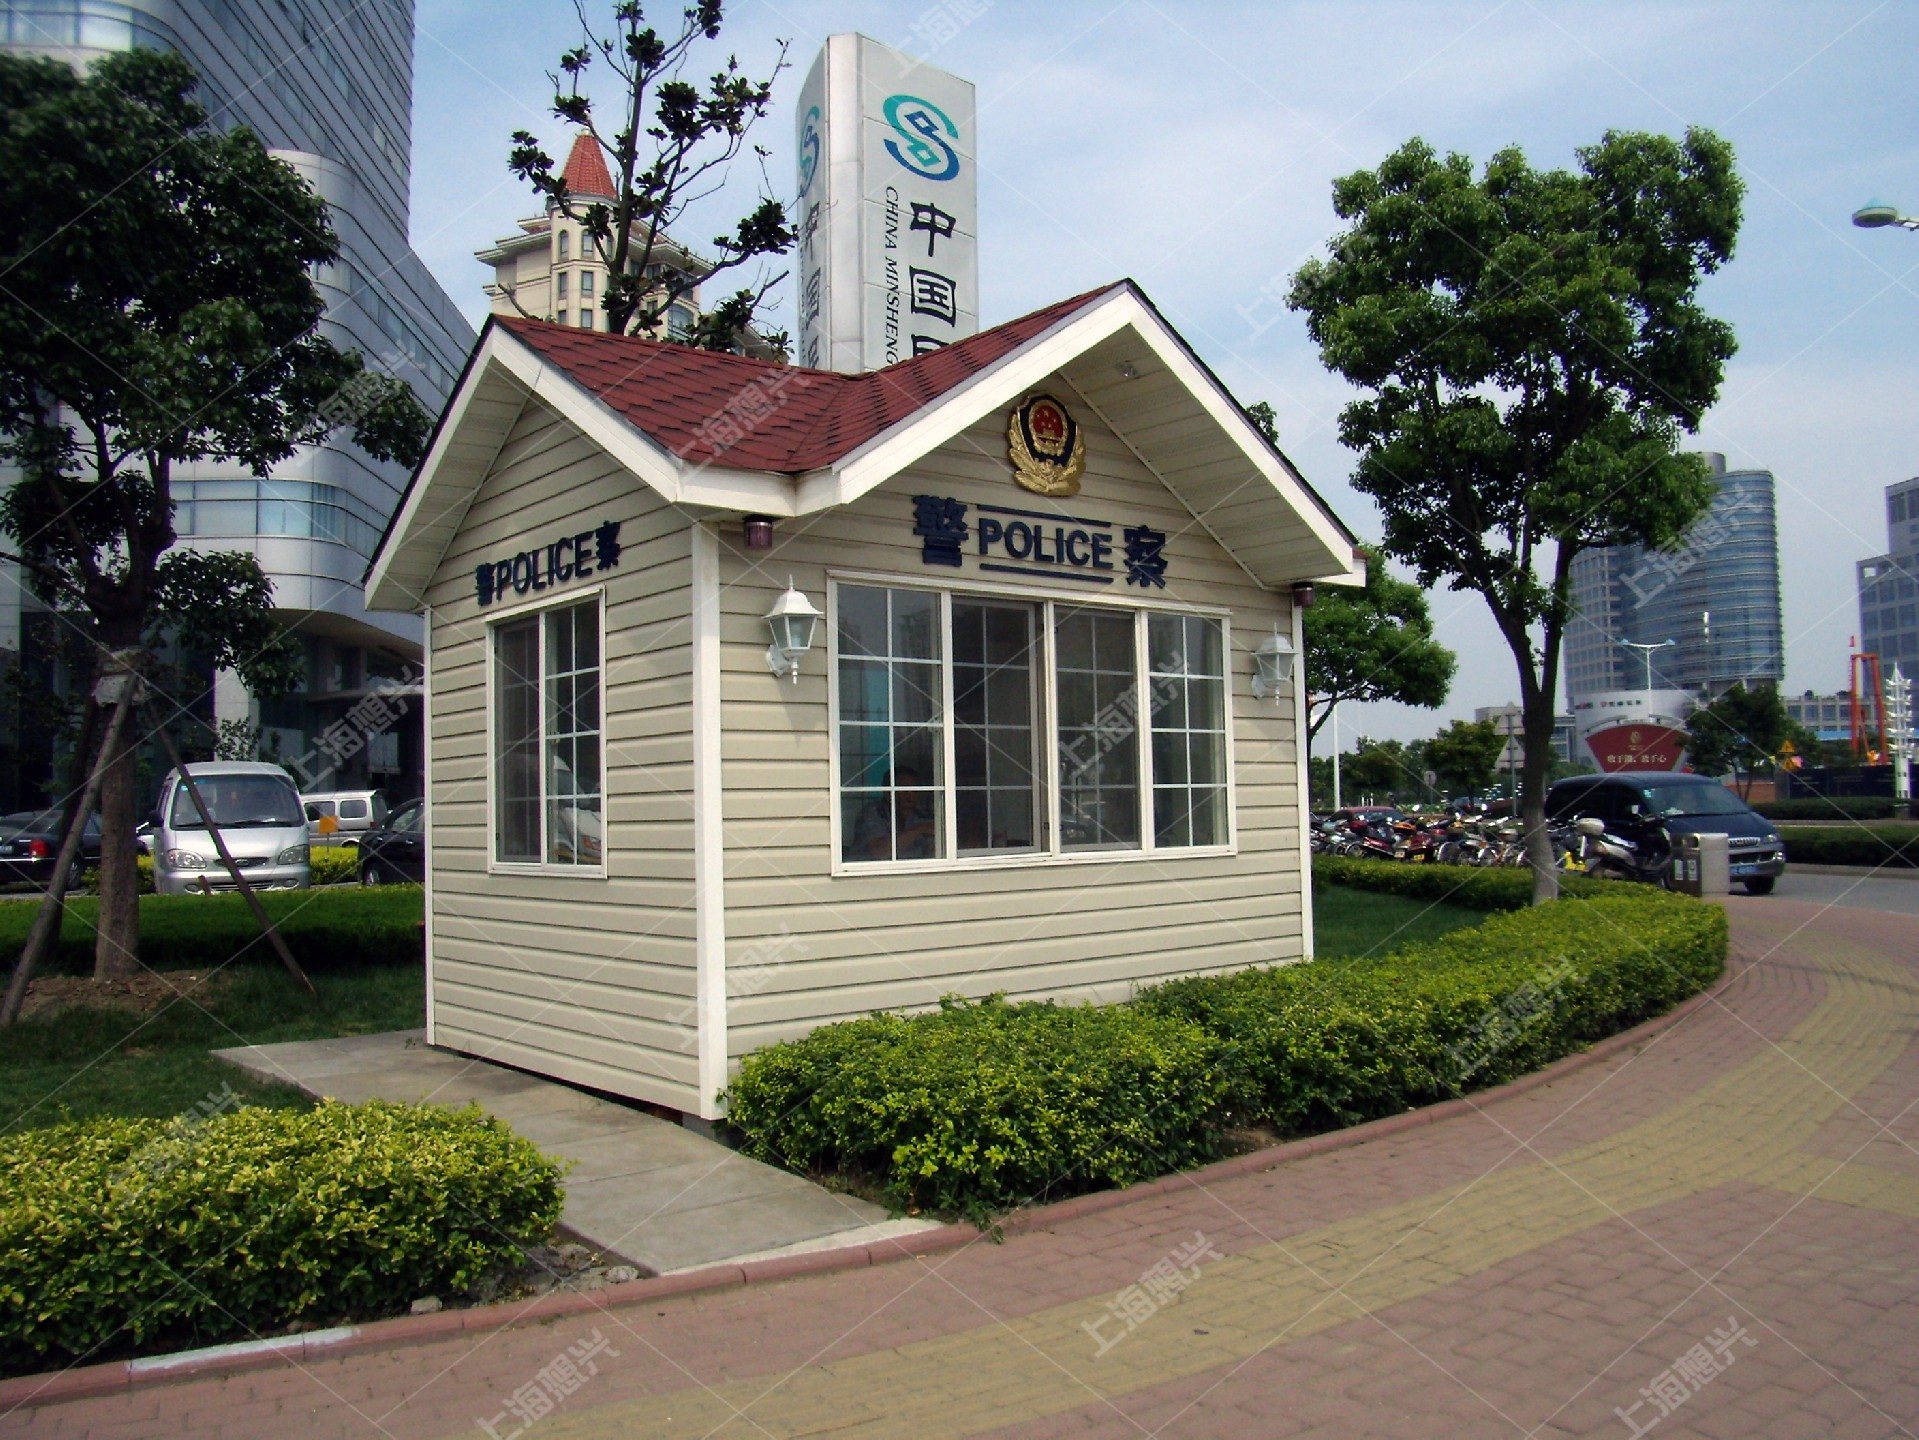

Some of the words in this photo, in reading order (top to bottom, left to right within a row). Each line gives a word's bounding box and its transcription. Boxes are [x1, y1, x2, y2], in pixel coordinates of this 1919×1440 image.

[885, 186, 899, 250] CHINA
[885, 256, 900, 365] MINSHENG
[496, 531, 593, 601] POLICE
[913, 495, 969, 567] 警
[978, 517, 1114, 570] POLICE
[1124, 525, 1169, 589] 察
